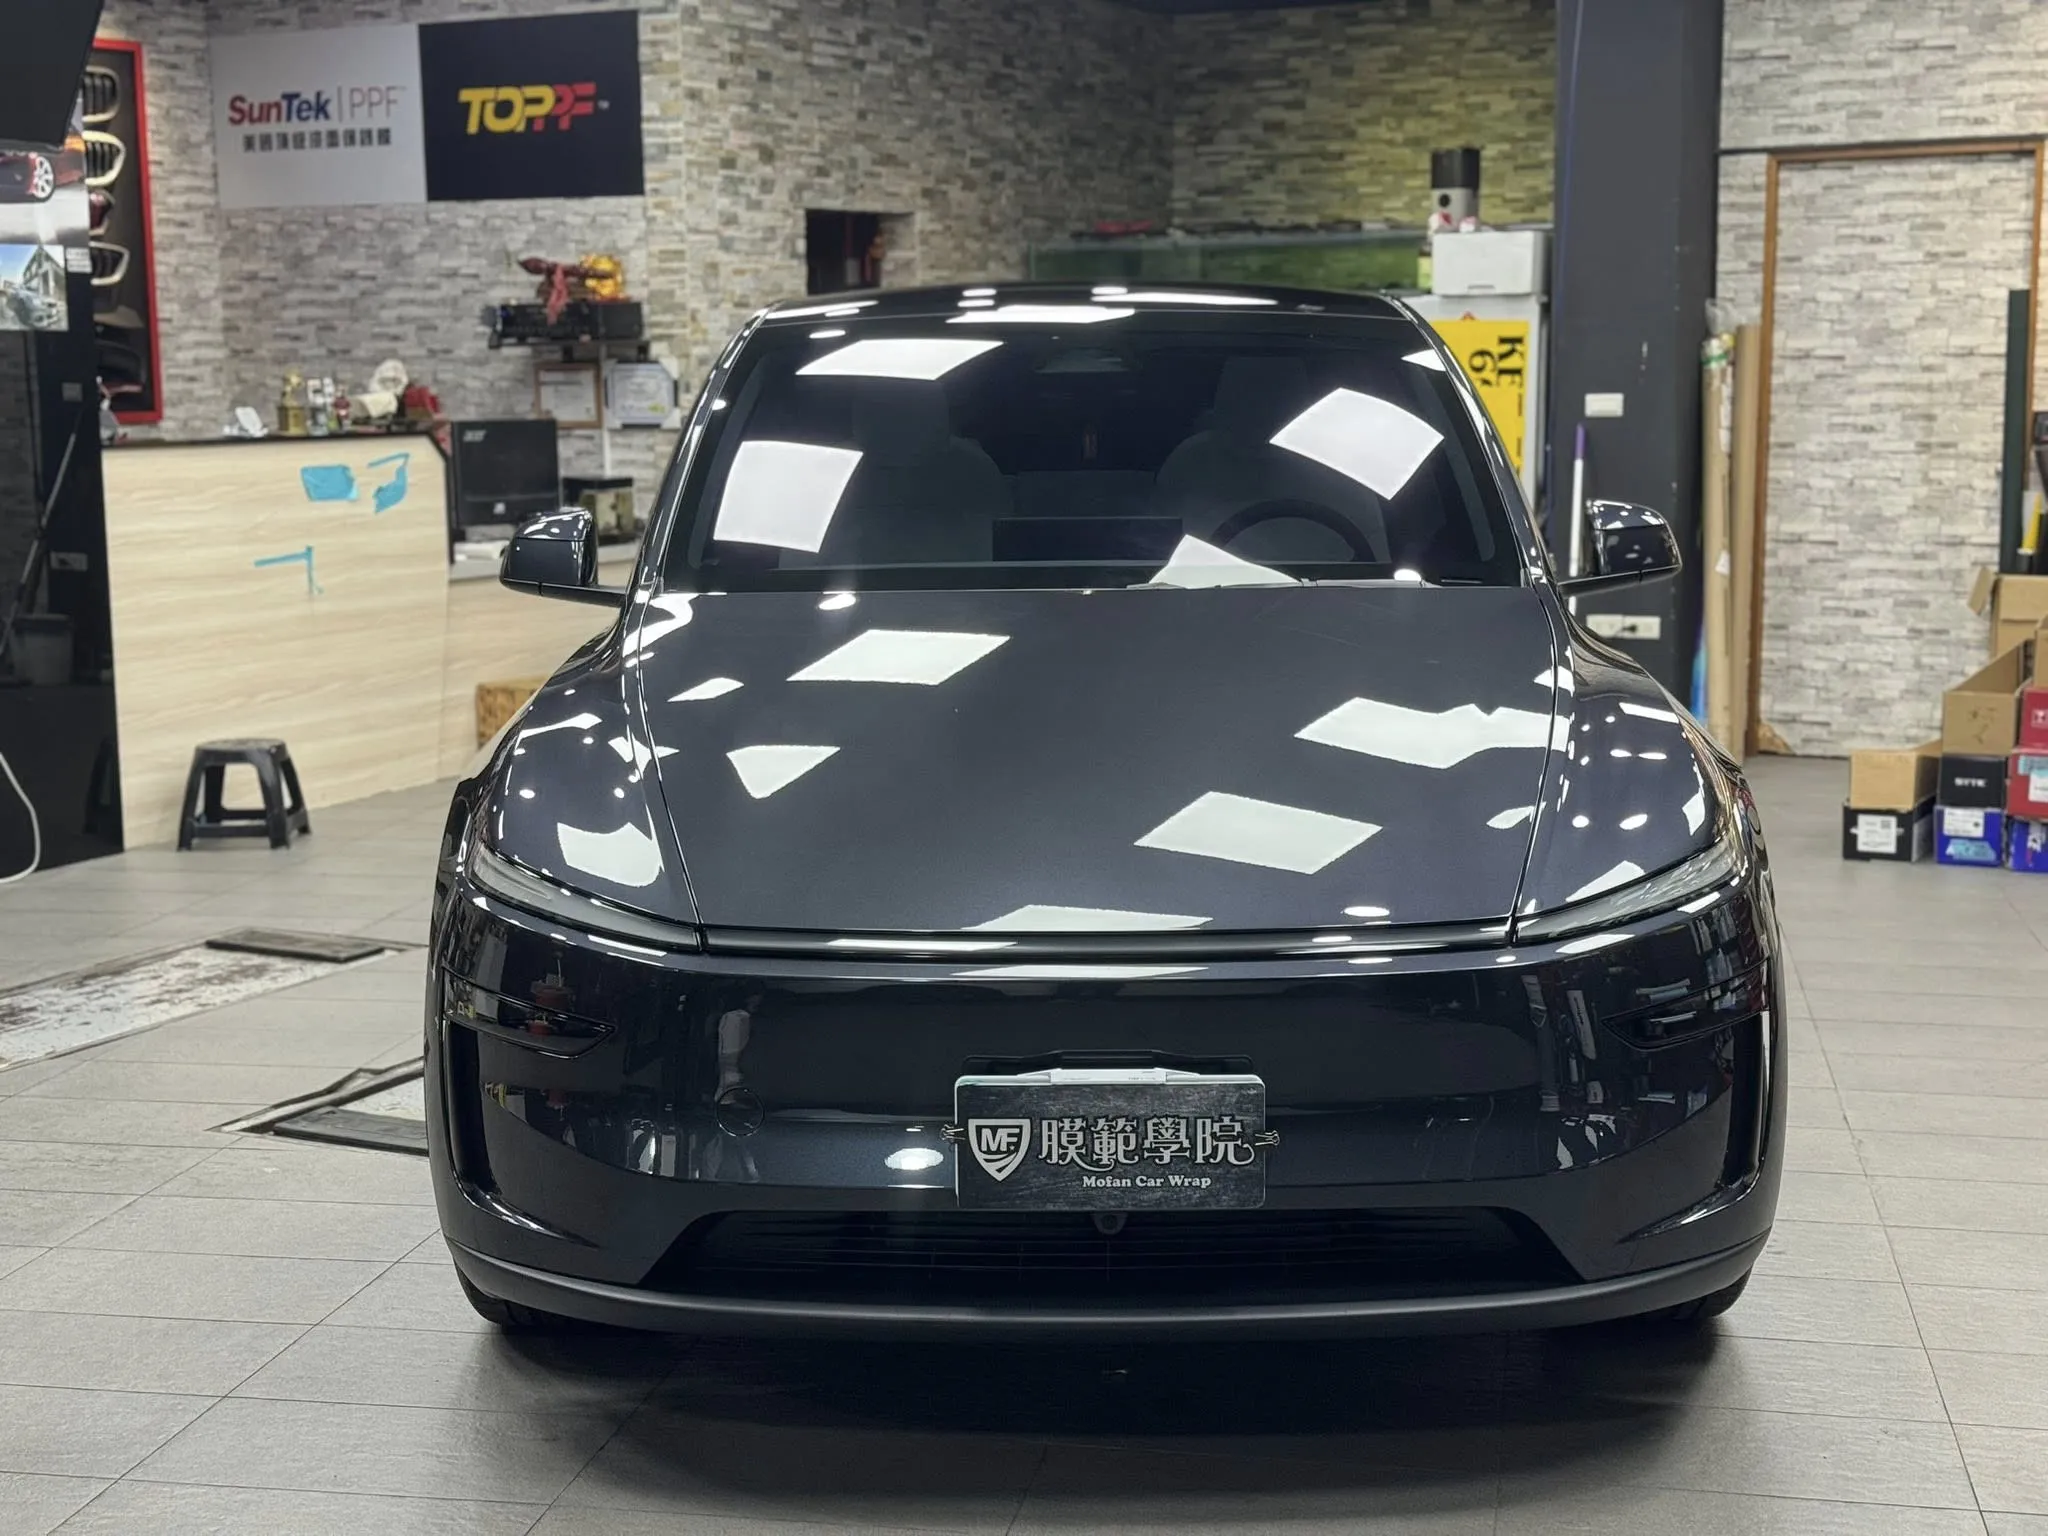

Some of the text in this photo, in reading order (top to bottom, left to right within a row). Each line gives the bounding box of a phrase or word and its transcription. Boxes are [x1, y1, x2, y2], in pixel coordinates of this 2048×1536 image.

[228, 85, 400, 126] SunTek PPF
[980, 1127, 1020, 1152] MF
[1038, 1115, 1255, 1171] 膜範學院
[1082, 1175, 1212, 1188] Mofan Car Wrap
